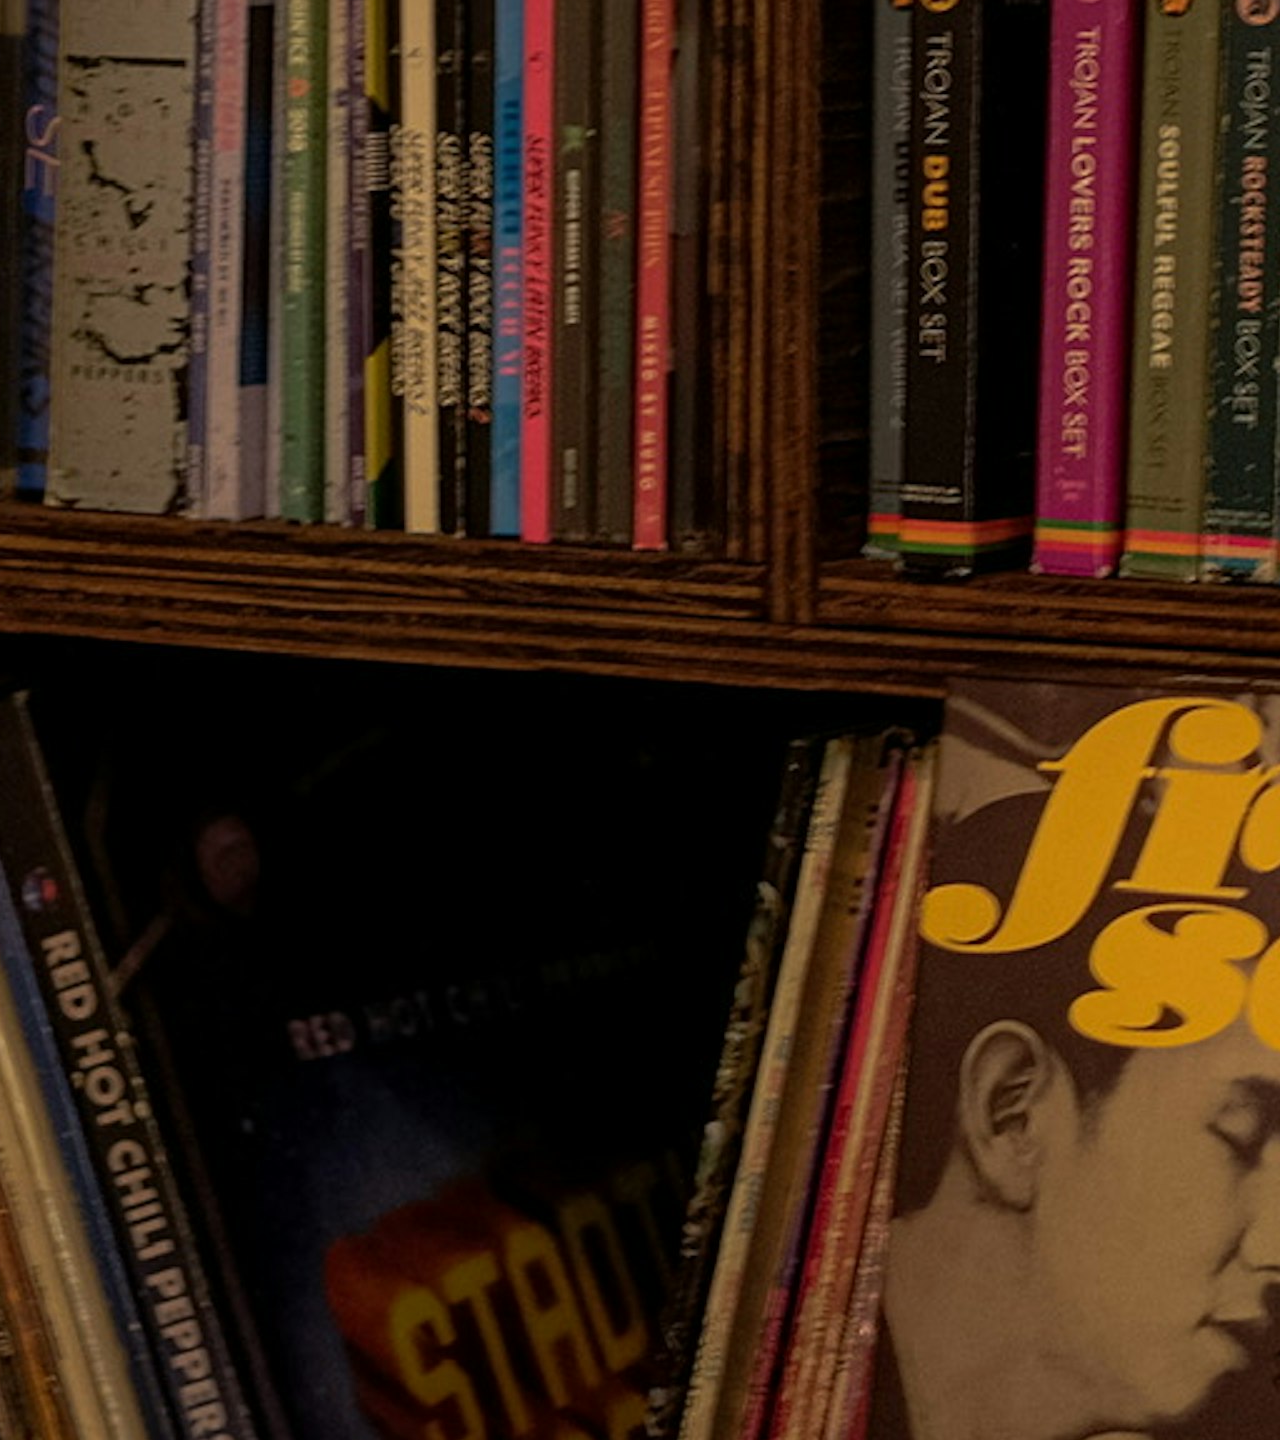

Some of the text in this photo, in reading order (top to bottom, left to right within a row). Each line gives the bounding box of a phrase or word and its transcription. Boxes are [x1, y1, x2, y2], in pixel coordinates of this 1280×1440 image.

[917, 30, 955, 366] TROJAN DUB BOX SET
[1058, 26, 1103, 462] TROJAN LOVERS ROCK BOX SET
[1230, 47, 1273, 430] TROJAN ROCKSTEADY BOX SET
[41, 927, 101, 1022] RED
[70, 1029, 126, 1127] HOT
[102, 1131, 164, 1256] CHILI
